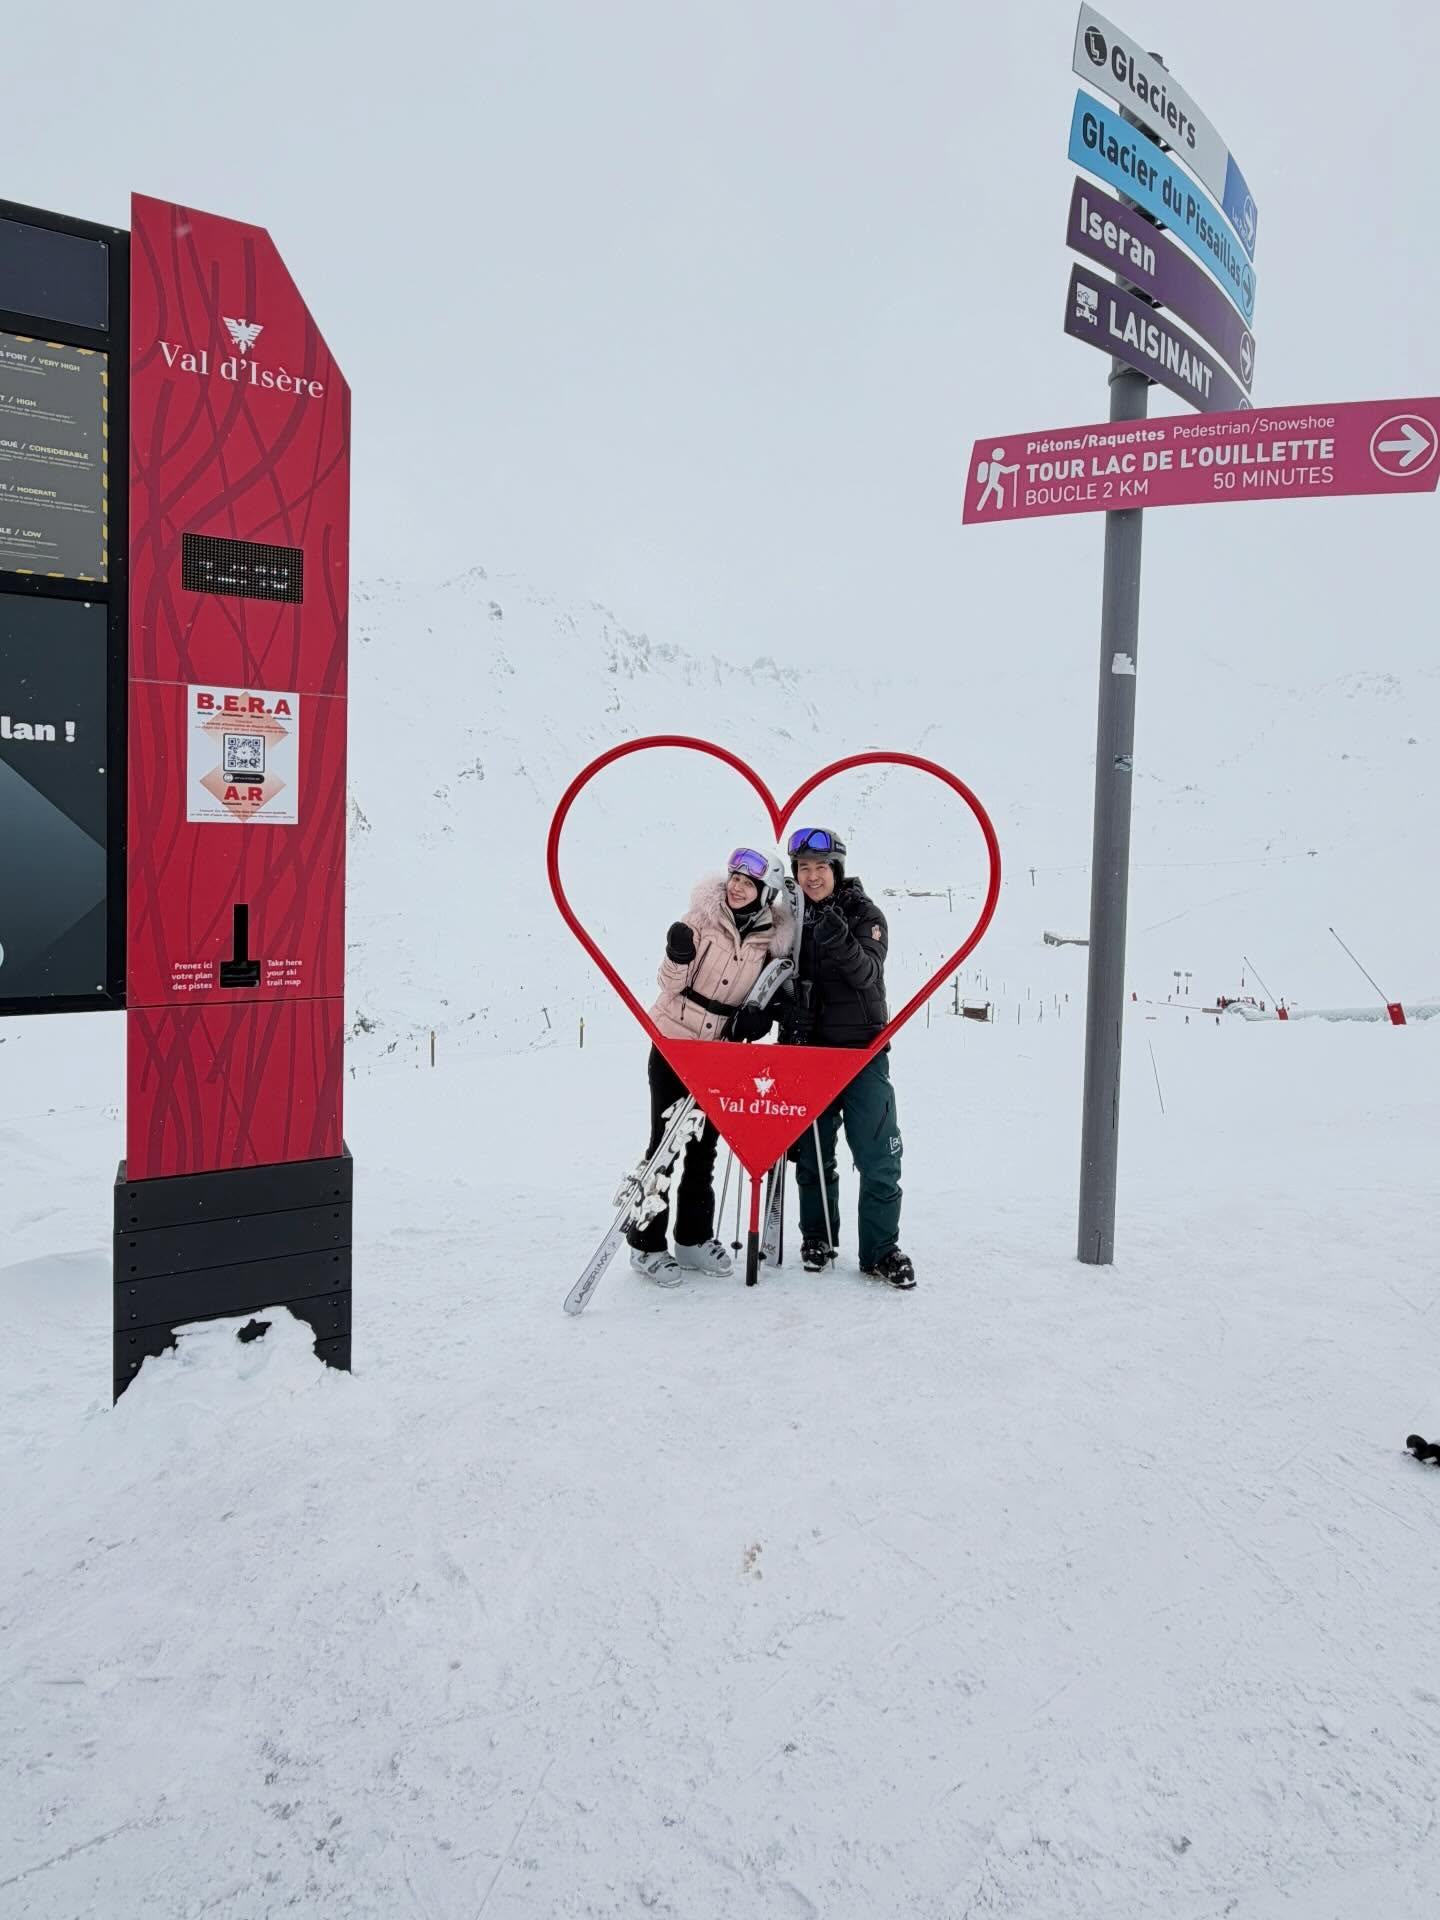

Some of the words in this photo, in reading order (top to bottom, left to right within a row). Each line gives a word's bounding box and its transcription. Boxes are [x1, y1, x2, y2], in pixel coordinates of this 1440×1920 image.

[1111, 45, 1196, 149] Glaciers
[1082, 112, 1158, 192] Glacier
[1162, 176, 1182, 218] du
[1186, 194, 1241, 288] Pissaillas
[1080, 197, 1156, 276] Iseran
[1109, 300, 1213, 399] LAISINANT
[6, 351, 27, 361] FORT
[39, 358, 60, 368] VERY
[60, 362, 80, 372] HIGH
[158, 340, 210, 375] Val
[220, 356, 324, 398] d'Isère
[16, 397, 37, 407] HIGH
[1027, 430, 1165, 455] Piétons/Raquettes
[1173, 415, 1335, 439] Pedestrian/Snowshoe
[29, 445, 89, 460] CONSIDERABLE
[1026, 459, 1085, 483] TOUR
[1092, 453, 1136, 476] LAC
[1143, 450, 1174, 472] DE
[1180, 438, 1335, 469] L'OUILLETTE
[1213, 472, 1235, 489] 50
[1242, 466, 1334, 487] MINUTES
[17, 486, 57, 498] MODERATE
[1025, 483, 1097, 506] BOUCLE
[1103, 481, 1113, 498] 2
[1119, 478, 1149, 497] KM
[22, 529, 42, 538] LOW
[197, 692, 291, 715] B.E.R.A
[0, 715, 55, 741] lan
[65, 720, 75, 743] !
[223, 785, 263, 801] A.R
[174, 962, 202, 970] Prenez
[203, 961, 213, 969] ici
[267, 959, 284, 967] Take
[285, 959, 303, 967] here
[286, 968, 297, 976] ski
[172, 982, 187, 990] des
[188, 982, 213, 991] pistes
[195, 972, 213, 981] plan
[267, 979, 283, 987] trail
[284, 979, 301, 987] map
[719, 1096, 744, 1113] Val
[749, 1099, 807, 1117] d'Isère
